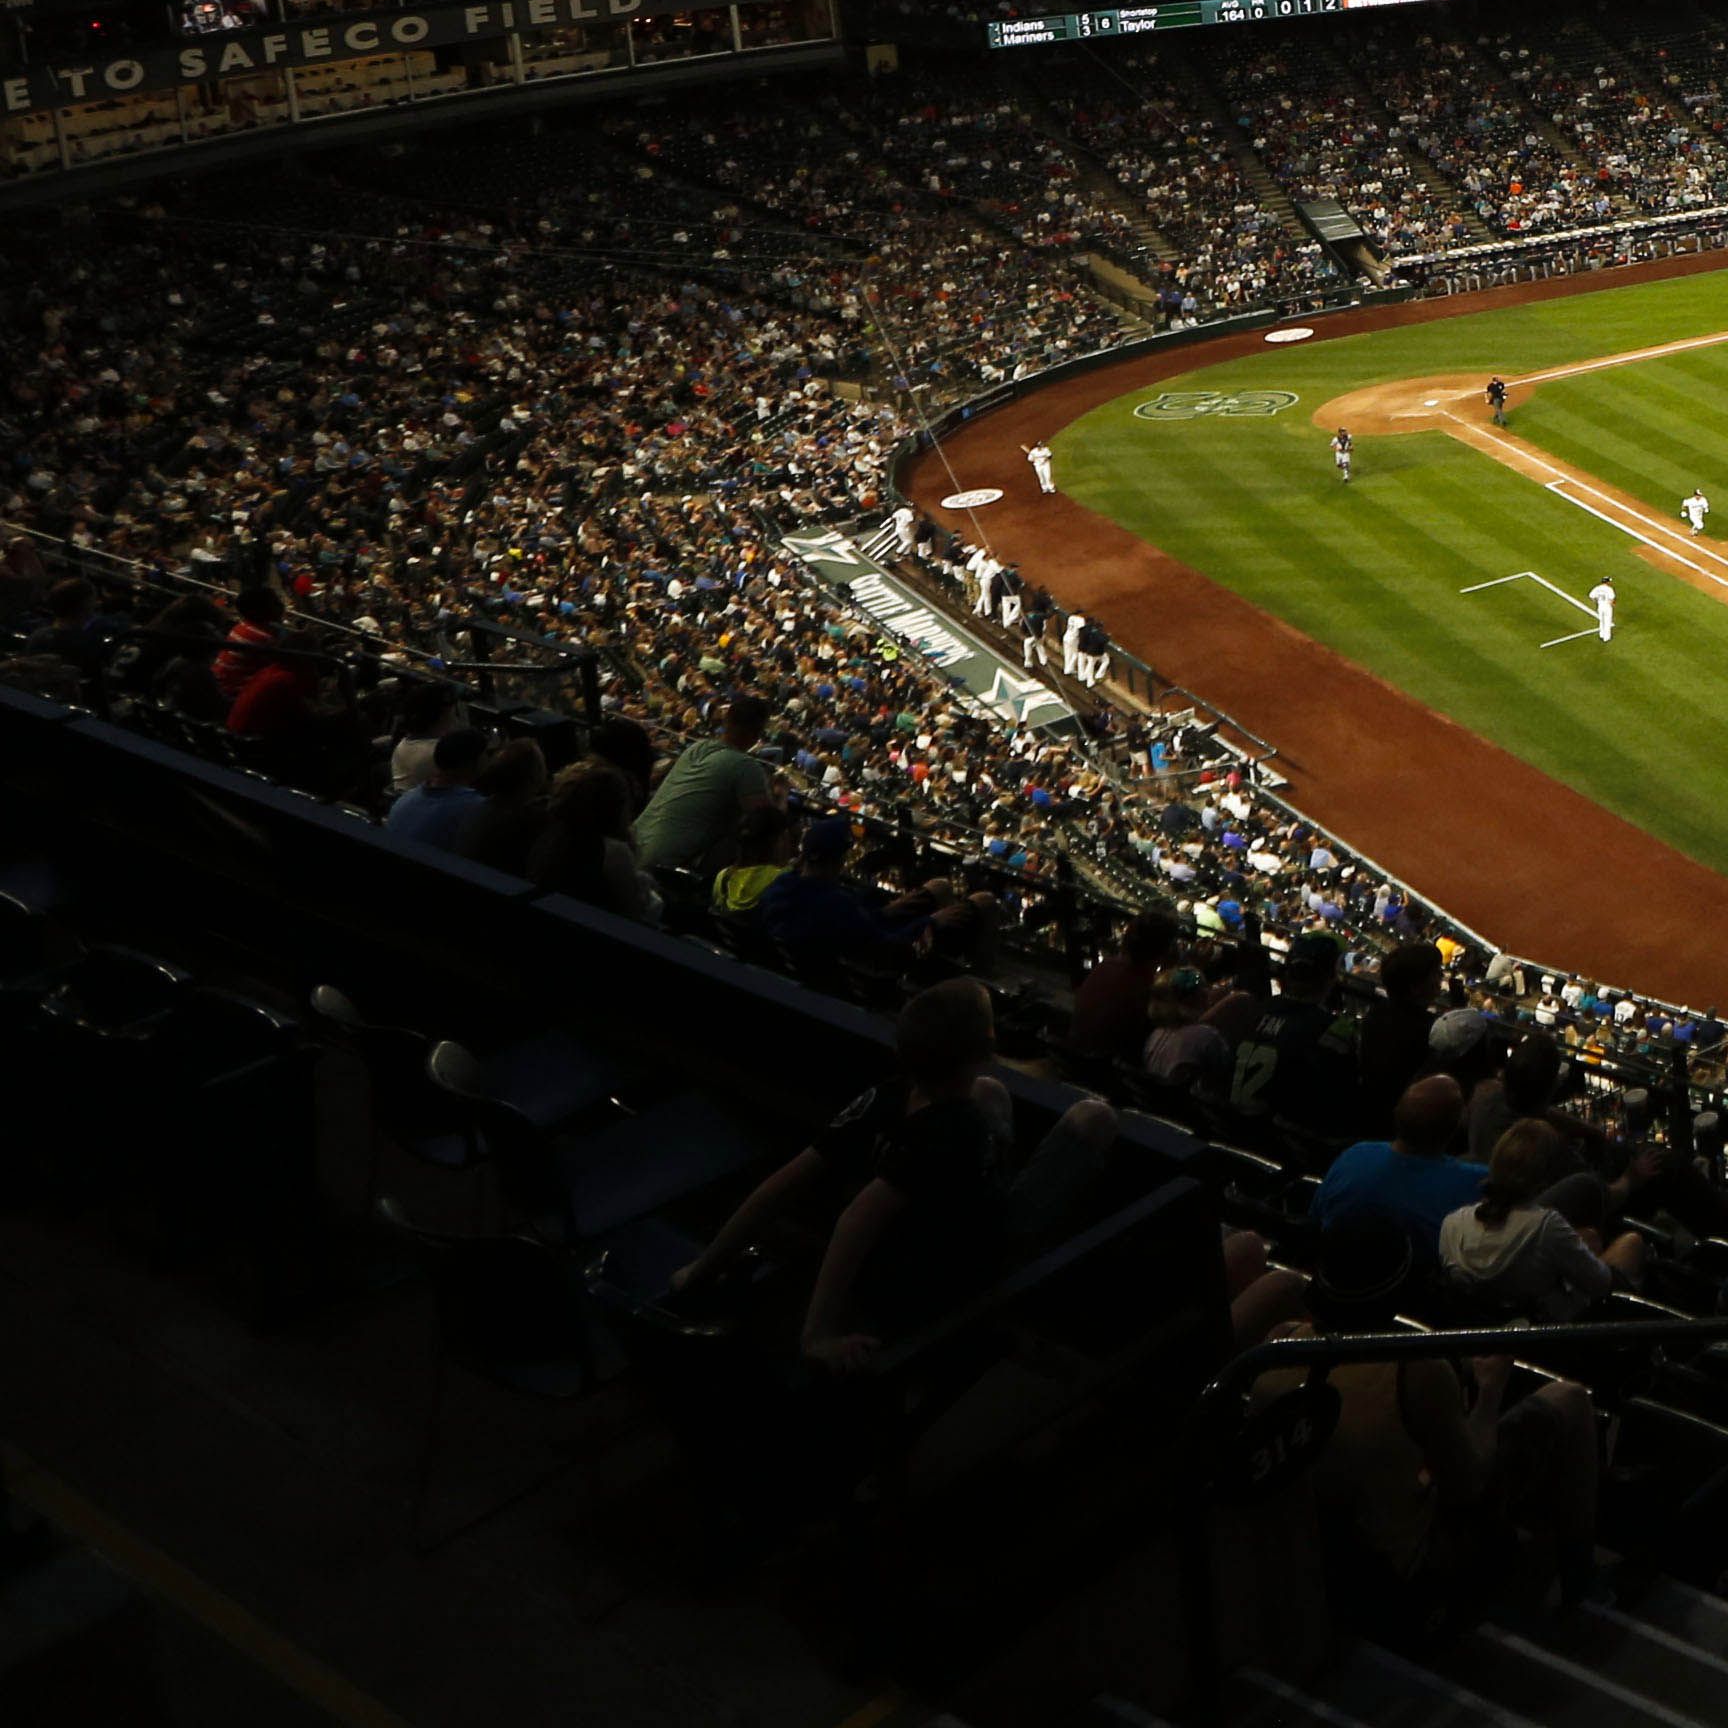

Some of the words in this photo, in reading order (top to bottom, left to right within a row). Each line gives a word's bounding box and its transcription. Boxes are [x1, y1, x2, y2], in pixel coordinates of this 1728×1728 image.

[1219, 9, 1245, 22] .164
[1255, 7, 1263, 18] 0
[1281, 1, 1291, 14] 0
[1304, 0, 1312, 11] 1
[1002, 19, 1044, 34] Indians
[1081, 13, 1090, 24] 5
[1003, 30, 1054, 45] Mariners
[1083, 25, 1091, 36] 3
[1101, 18, 1110, 29] 6
[1121, 18, 1157, 33] Taylor
[58, 58, 145, 98] TO
[178, 15, 430, 79] SAFECO
